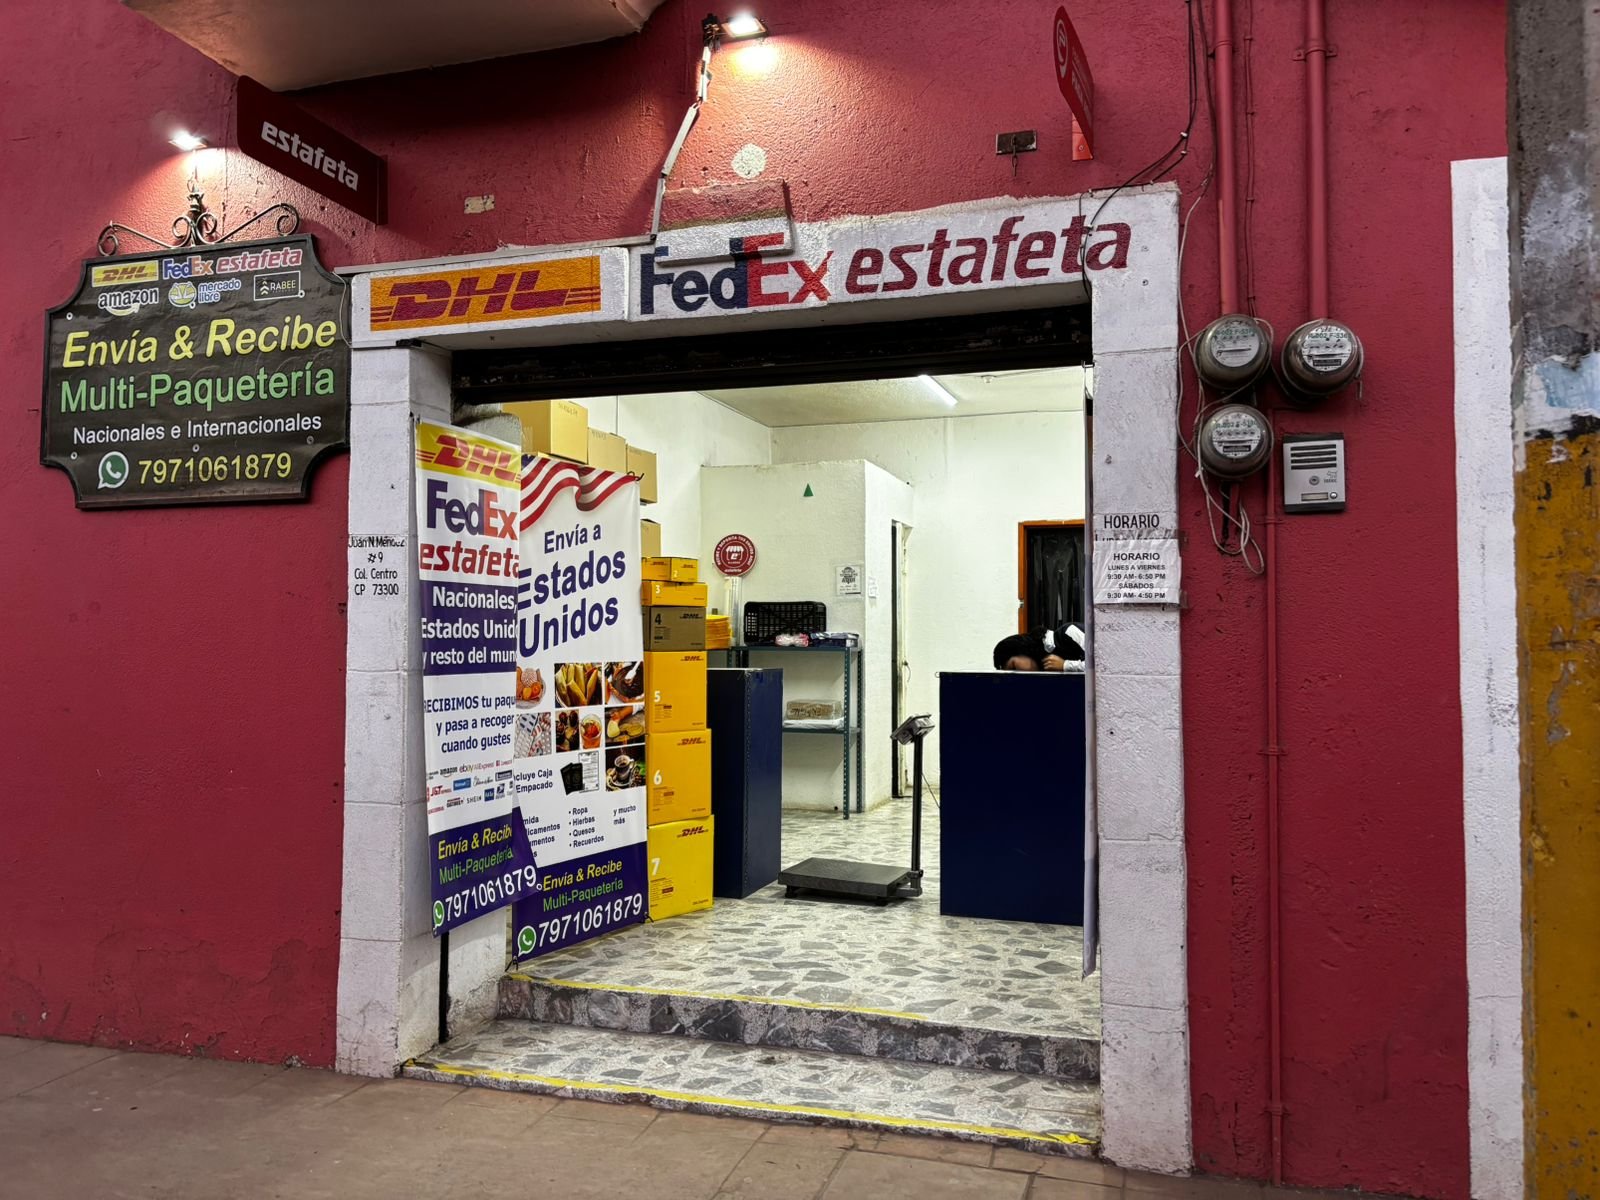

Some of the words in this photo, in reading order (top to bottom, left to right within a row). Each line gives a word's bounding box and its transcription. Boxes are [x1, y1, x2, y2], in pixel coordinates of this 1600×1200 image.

[261, 121, 359, 191] estafeta
[101, 265, 149, 281] DHL
[162, 255, 214, 279] FedEx
[215, 247, 303, 274] estafeta
[639, 232, 832, 315] FedEx
[845, 213, 1132, 294] estafeta
[98, 288, 159, 309] amazon
[198, 279, 242, 293] mercado
[269, 279, 296, 292] RABEE
[388, 269, 570, 321] DHL
[198, 291, 220, 304] libre
[62, 326, 158, 368] Envía
[169, 325, 194, 360] &
[206, 315, 337, 358] Recibe
[60, 361, 335, 413] Multi-Paquetería
[73, 423, 165, 445] Nacionales
[170, 425, 181, 438] e
[187, 412, 322, 438] Internacionales
[433, 434, 517, 481] DHL
[138, 452, 293, 484] 7971061879
[426, 478, 518, 540] FedEx
[1104, 514, 1160, 529] HORARIO
[544, 523, 588, 554] Envía
[592, 524, 601, 540] a
[1113, 552, 1160, 561] HORARIO
[354, 568, 368, 579] Col.
[371, 568, 398, 579] Centro
[517, 550, 626, 610] Estados
[673, 570, 679, 578] 2
[354, 583, 366, 595] CP
[372, 583, 399, 595] 73300
[654, 585, 661, 594] 3
[421, 617, 480, 639] Estados
[519, 597, 619, 658] Unidos
[654, 613, 662, 625] 4
[430, 648, 464, 665] resto
[468, 646, 487, 664] del
[481, 696, 492, 708] tu
[654, 691, 661, 702] 5
[436, 722, 442, 736] y
[445, 719, 469, 735] pasa
[471, 719, 477, 729] a
[480, 714, 514, 729] recoger
[441, 736, 478, 753] cuando
[481, 733, 511, 751] gustes
[680, 736, 702, 746] DHL
[537, 768, 553, 779] Caja
[653, 769, 662, 785] 6
[516, 780, 553, 793] Empacado
[572, 807, 588, 816] Ropa
[613, 809, 617, 817] y
[618, 804, 636, 814] mucho
[572, 816, 595, 827] Hierbas
[573, 826, 595, 838] Quesos
[573, 834, 605, 848] Recuerdos
[681, 826, 704, 837] DHL
[438, 837, 469, 860] Envía
[471, 832, 480, 849] &
[542, 871, 573, 892] Envía
[576, 867, 584, 882] &
[586, 859, 623, 880] Recibe
[651, 857, 661, 876] 7
[445, 864, 537, 921] 7971061879
[543, 878, 624, 913] Multi-Paquetería
[538, 893, 643, 948] 7971061879
